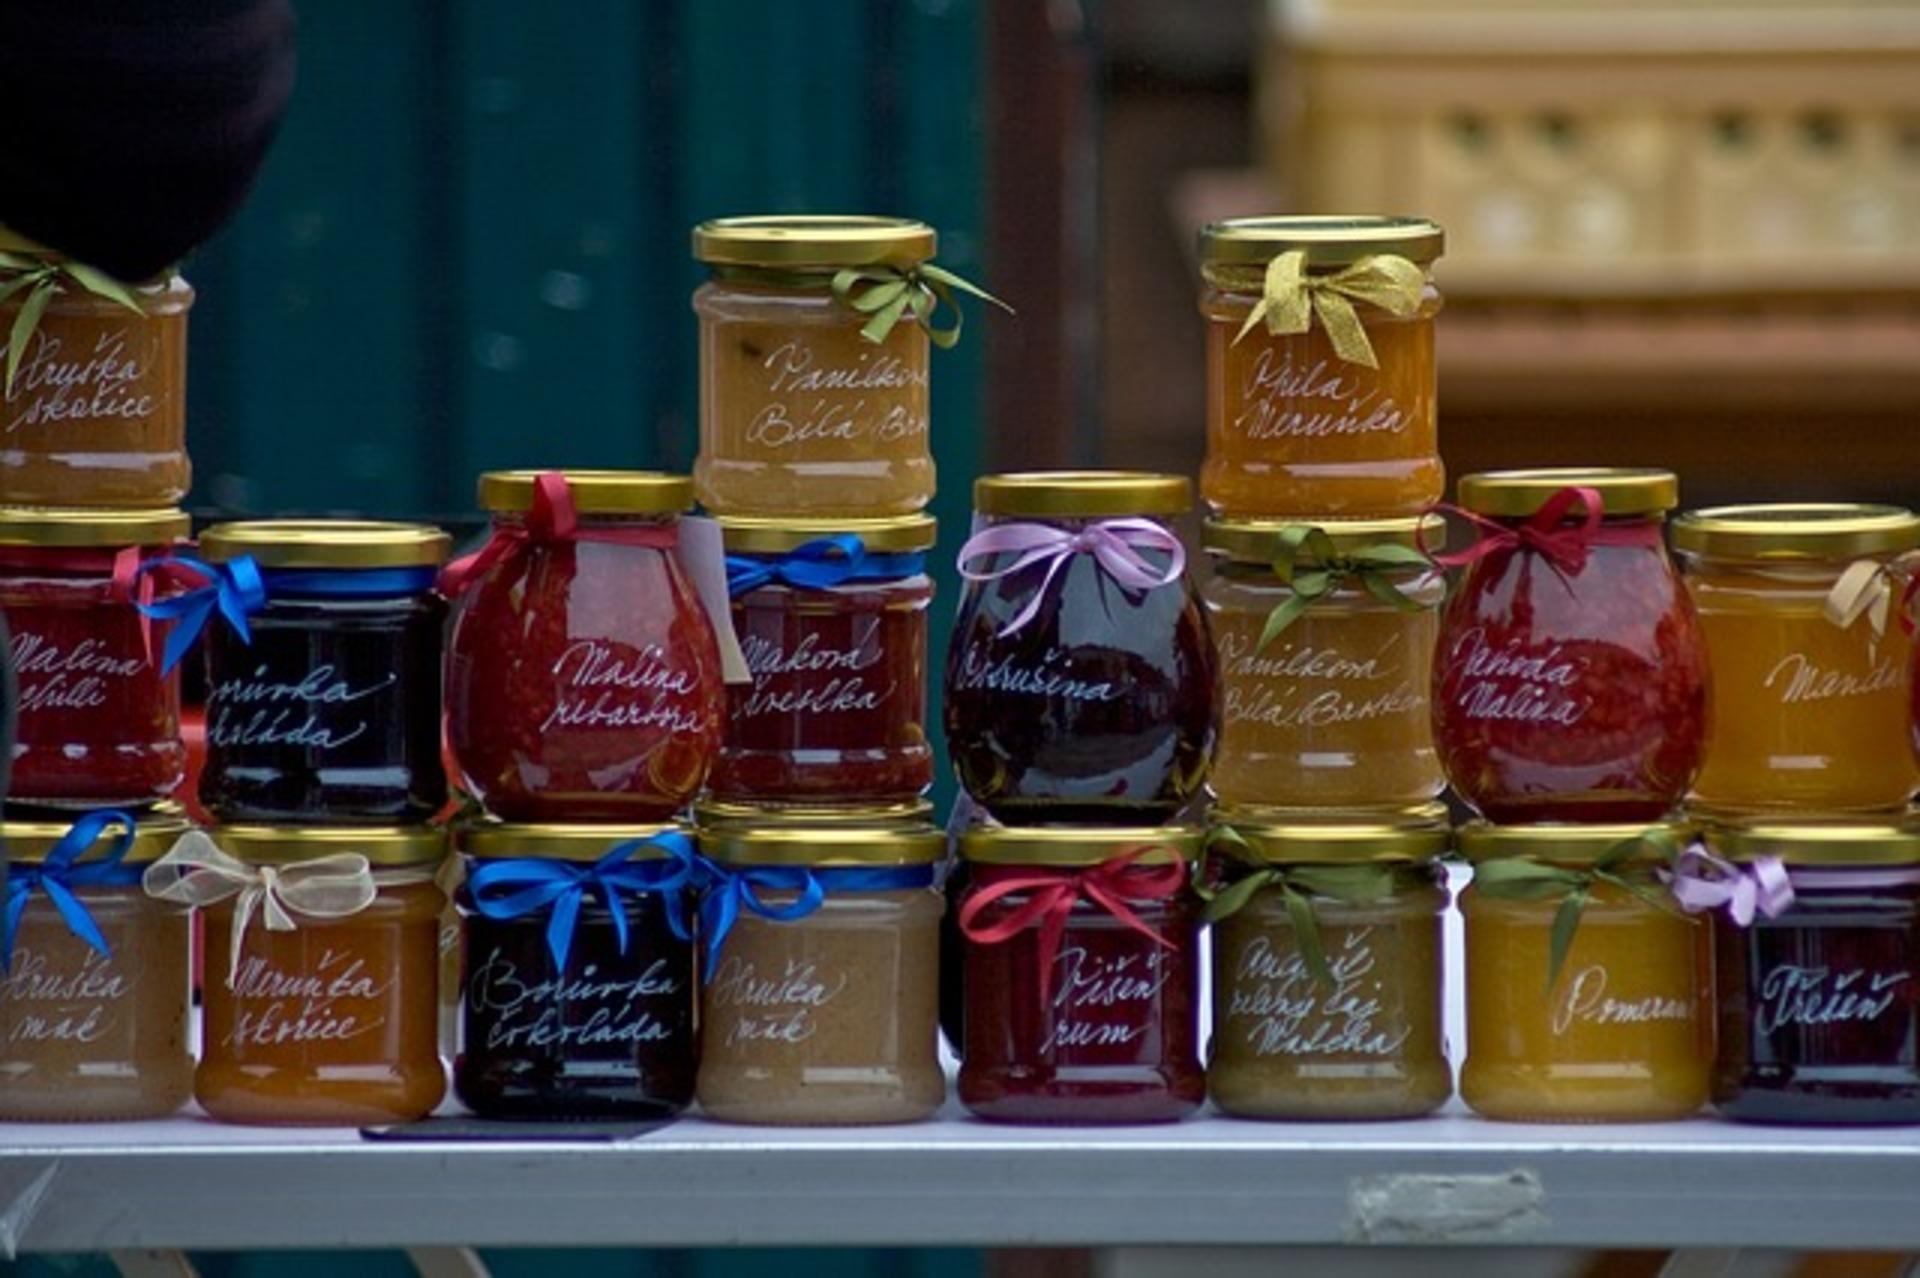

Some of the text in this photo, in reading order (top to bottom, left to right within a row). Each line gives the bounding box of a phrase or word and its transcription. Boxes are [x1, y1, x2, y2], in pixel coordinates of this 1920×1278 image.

[551, 640, 703, 695] Malina
[1459, 680, 1594, 725] Malina
[1039, 1018, 1153, 1055] rum
